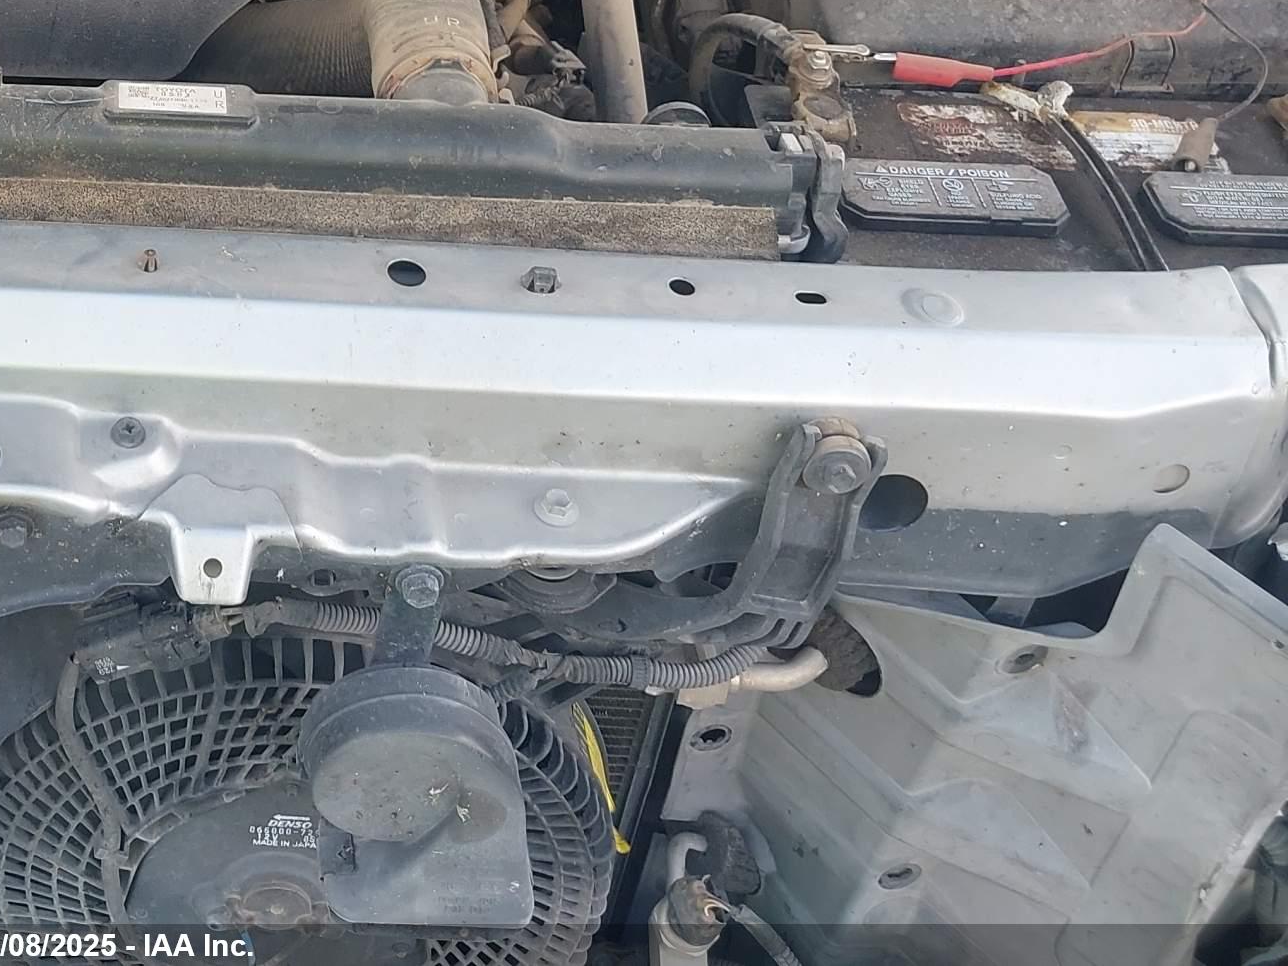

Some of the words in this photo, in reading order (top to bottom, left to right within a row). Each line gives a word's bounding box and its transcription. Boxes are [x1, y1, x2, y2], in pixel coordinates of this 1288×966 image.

[888, 165, 945, 176] DANGER
[268, 819, 312, 829] DENSO
[252, 838, 278, 846] MADE
[292, 841, 317, 849] JAPA
